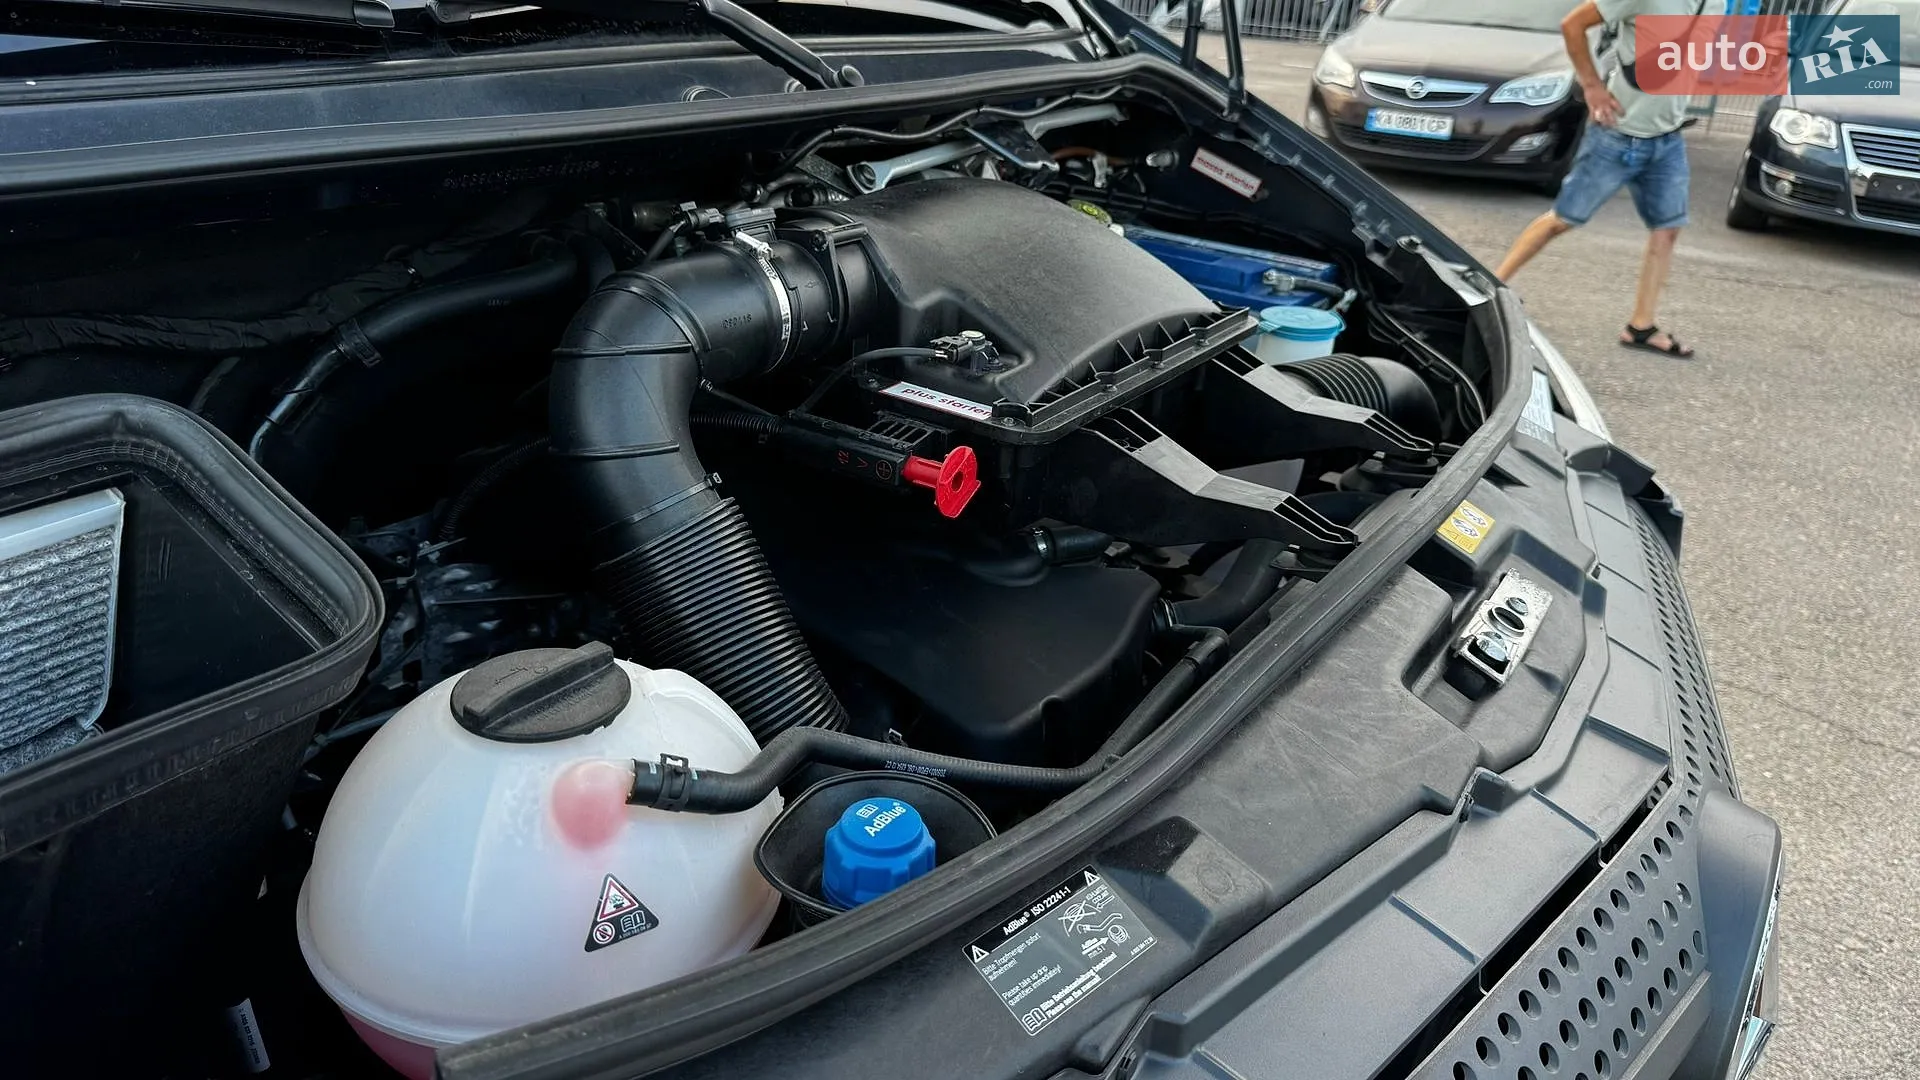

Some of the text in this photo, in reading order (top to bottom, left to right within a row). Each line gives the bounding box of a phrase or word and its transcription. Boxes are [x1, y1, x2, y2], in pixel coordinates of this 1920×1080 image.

[902, 387, 937, 400] plus
[1031, 904, 1045, 916] ISO
[1043, 886, 1071, 908] 22241-1
[982, 963, 996, 975] Bitte
[1025, 933, 1040, 946] sofort
[1002, 986, 1021, 1000] Please
[1019, 977, 1032, 988] take
[1030, 972, 1039, 981] up
[1008, 986, 1033, 1006] quantities
[1045, 1003, 1065, 1018] Please
[1071, 989, 1083, 999] the
